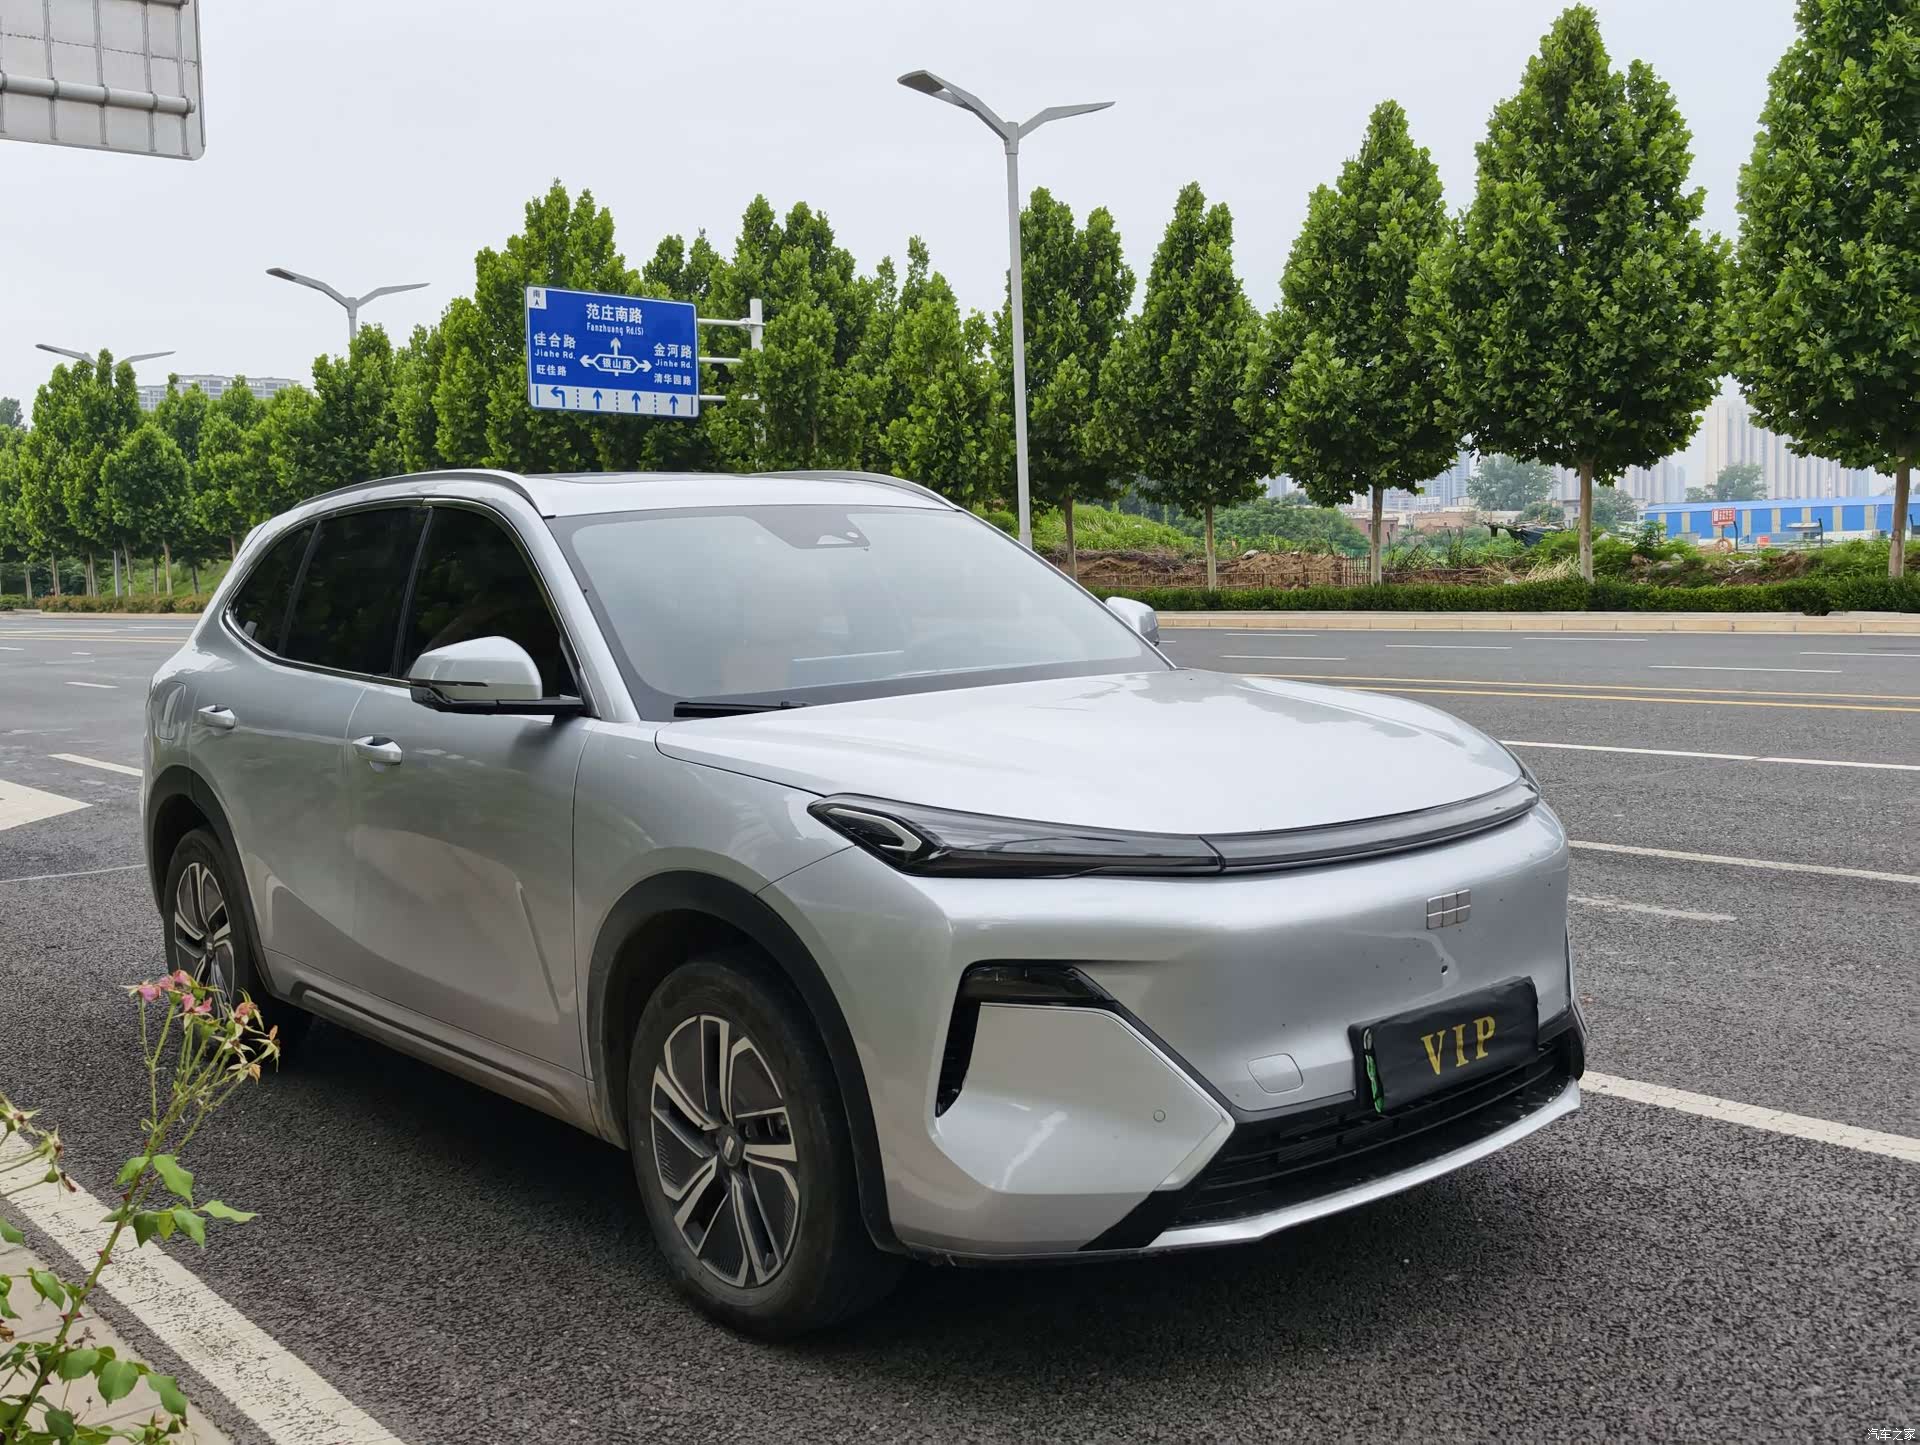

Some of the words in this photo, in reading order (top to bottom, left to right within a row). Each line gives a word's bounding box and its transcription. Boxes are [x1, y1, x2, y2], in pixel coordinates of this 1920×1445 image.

[586, 303, 643, 324] 范庄南路
[586, 322, 623, 336] Fanzhuang
[534, 330, 576, 350] 佳合路
[534, 348, 560, 358] Jiahe
[562, 351, 576, 360] Rd.
[654, 342, 692, 359] 金河路
[536, 364, 567, 376] 旺佳路
[655, 358, 678, 368] Jinhe
[680, 360, 692, 368] Rd.
[1420, 1016, 1496, 1076] VIP
